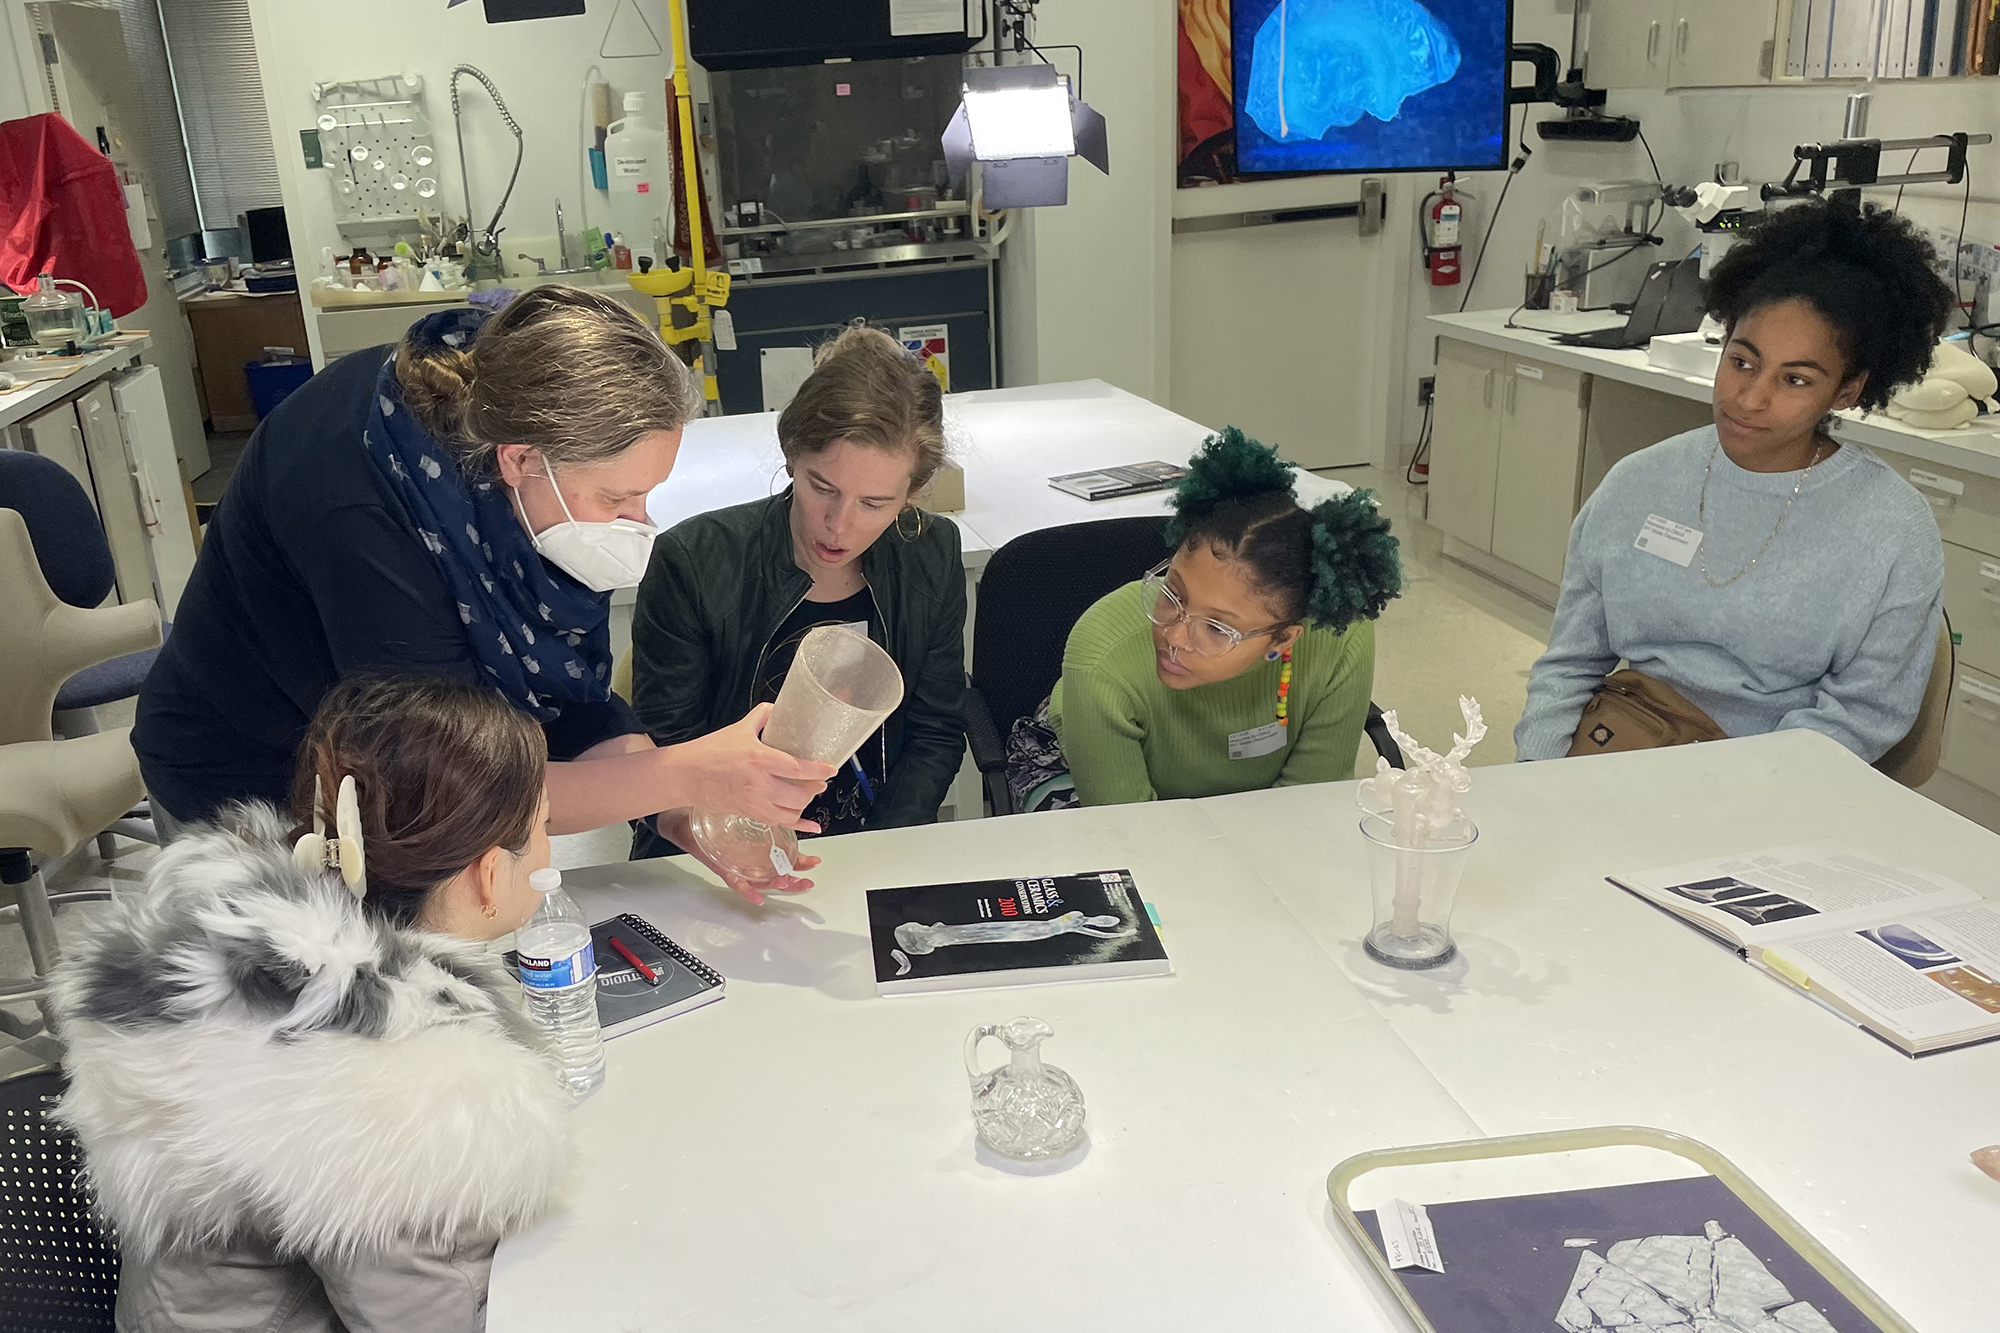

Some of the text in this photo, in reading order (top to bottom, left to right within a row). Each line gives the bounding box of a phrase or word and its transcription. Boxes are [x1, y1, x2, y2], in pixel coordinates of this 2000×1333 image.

[998, 897, 1018, 917] 2010
[1015, 881, 1033, 915] CONSERVATION
[1027, 880, 1049, 914] CERAMICS
[1041, 879, 1064, 908] GLASS &
